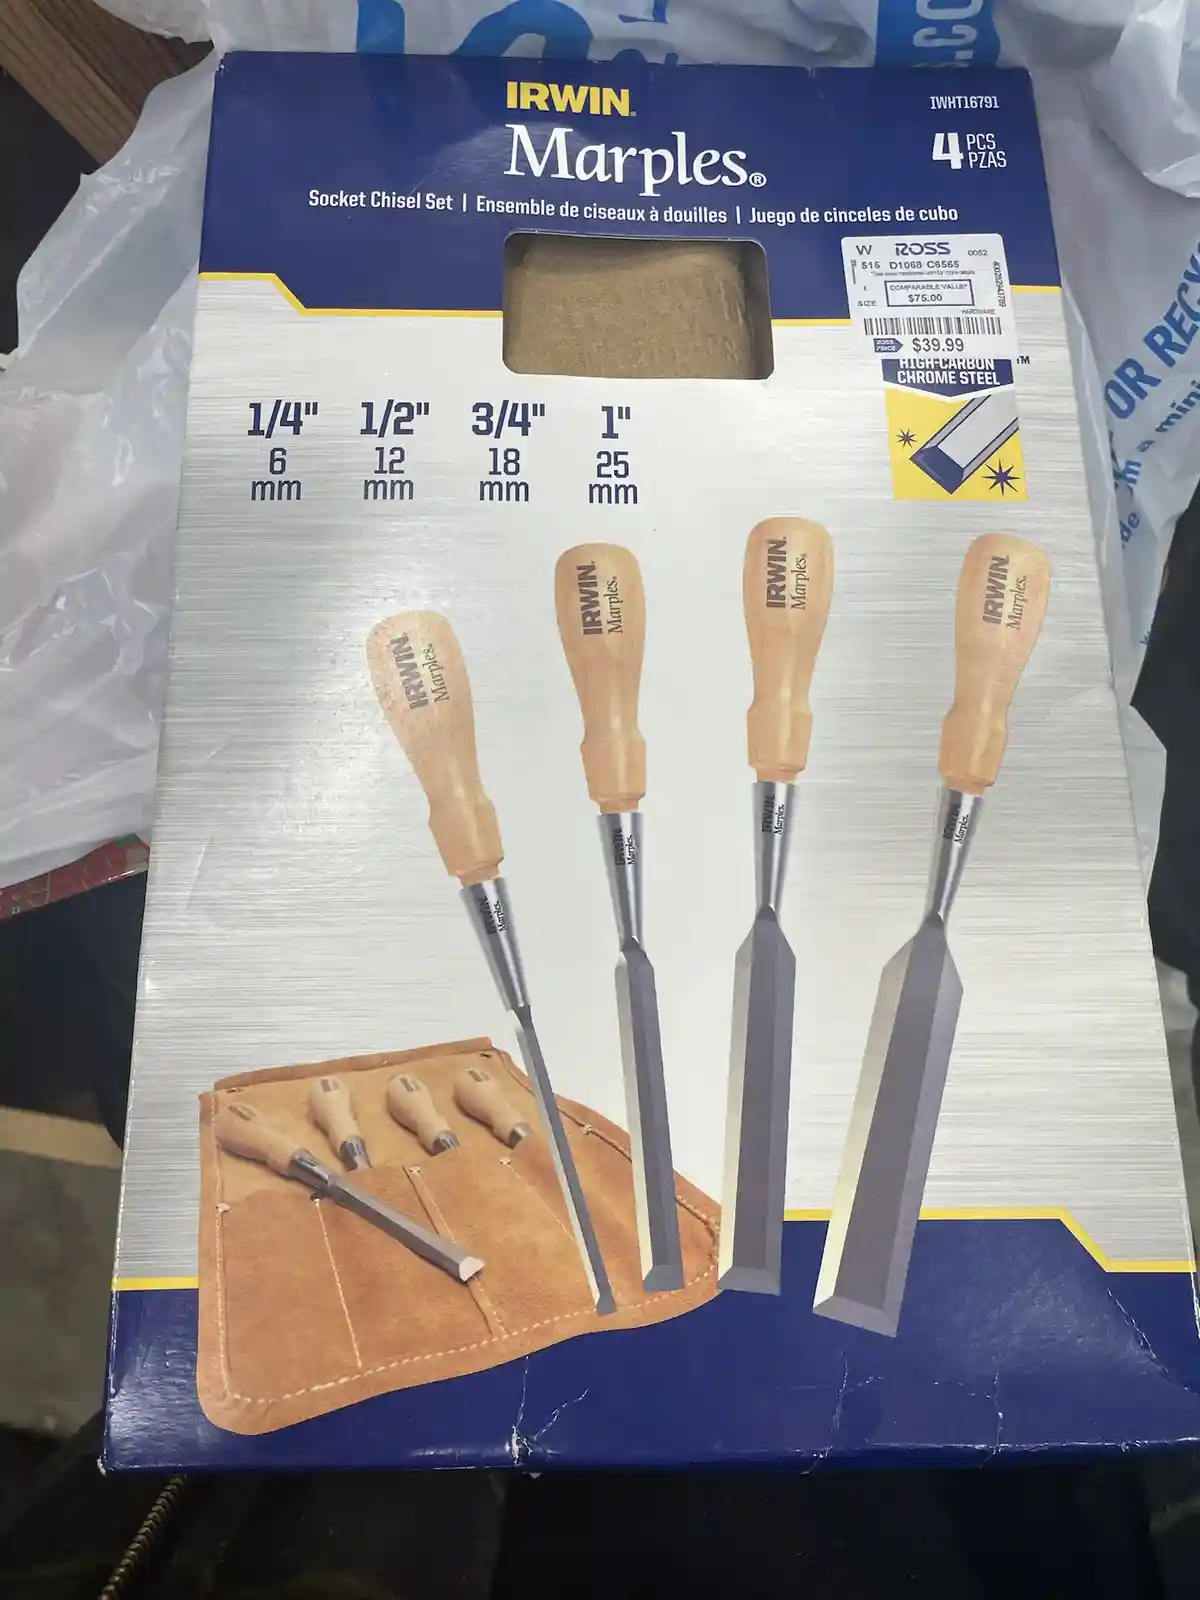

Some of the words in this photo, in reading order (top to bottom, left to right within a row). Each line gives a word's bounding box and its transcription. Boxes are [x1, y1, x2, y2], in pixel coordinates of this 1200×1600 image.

[507, 81, 632, 117] IRWIN
[930, 95, 1000, 109] IWHT16791
[932, 132, 964, 170] 4
[966, 133, 997, 150] PCS
[968, 150, 1007, 168] PZAS
[309, 189, 366, 207] Socket
[370, 191, 421, 209] Chisel
[425, 193, 453, 211] Set
[476, 195, 555, 216] Ensemble
[560, 201, 579, 218] de
[583, 202, 645, 221] ciseaux
[650, 206, 659, 222] à
[663, 205, 727, 223] douilles
[749, 207, 796, 227] Juego
[800, 207, 820, 223] de
[824, 205, 891, 222] cinceles
[895, 205, 914, 221] de
[918, 204, 958, 221] cubo
[856, 245, 872, 255] W
[895, 242, 951, 256] ROSS
[908, 293, 943, 303] $75.00
[912, 337, 965, 353] $39.99
[897, 371, 957, 385] CHROME
[960, 372, 1001, 385] STEEL
[900, 359, 995, 370] HIGH-CARBON
[1104, 357, 1162, 420] OR
[247, 400, 318, 438] 1/4"
[360, 400, 430, 438] 1/2"
[472, 400, 546, 438] 3/4"
[601, 405, 631, 439] 1"
[269, 447, 286, 475] 6
[374, 447, 405, 475] 12
[488, 447, 520, 476] 18
[596, 450, 629, 479] 25
[251, 480, 301, 501] mm
[364, 479, 414, 500] mm
[479, 480, 529, 502] mm
[589, 482, 638, 504] mm
[766, 537, 787, 609] IRWIN
[576, 561, 602, 636] IRWIN
[982, 555, 1009, 625] IRWIN
[390, 634, 428, 710] IRWIN
